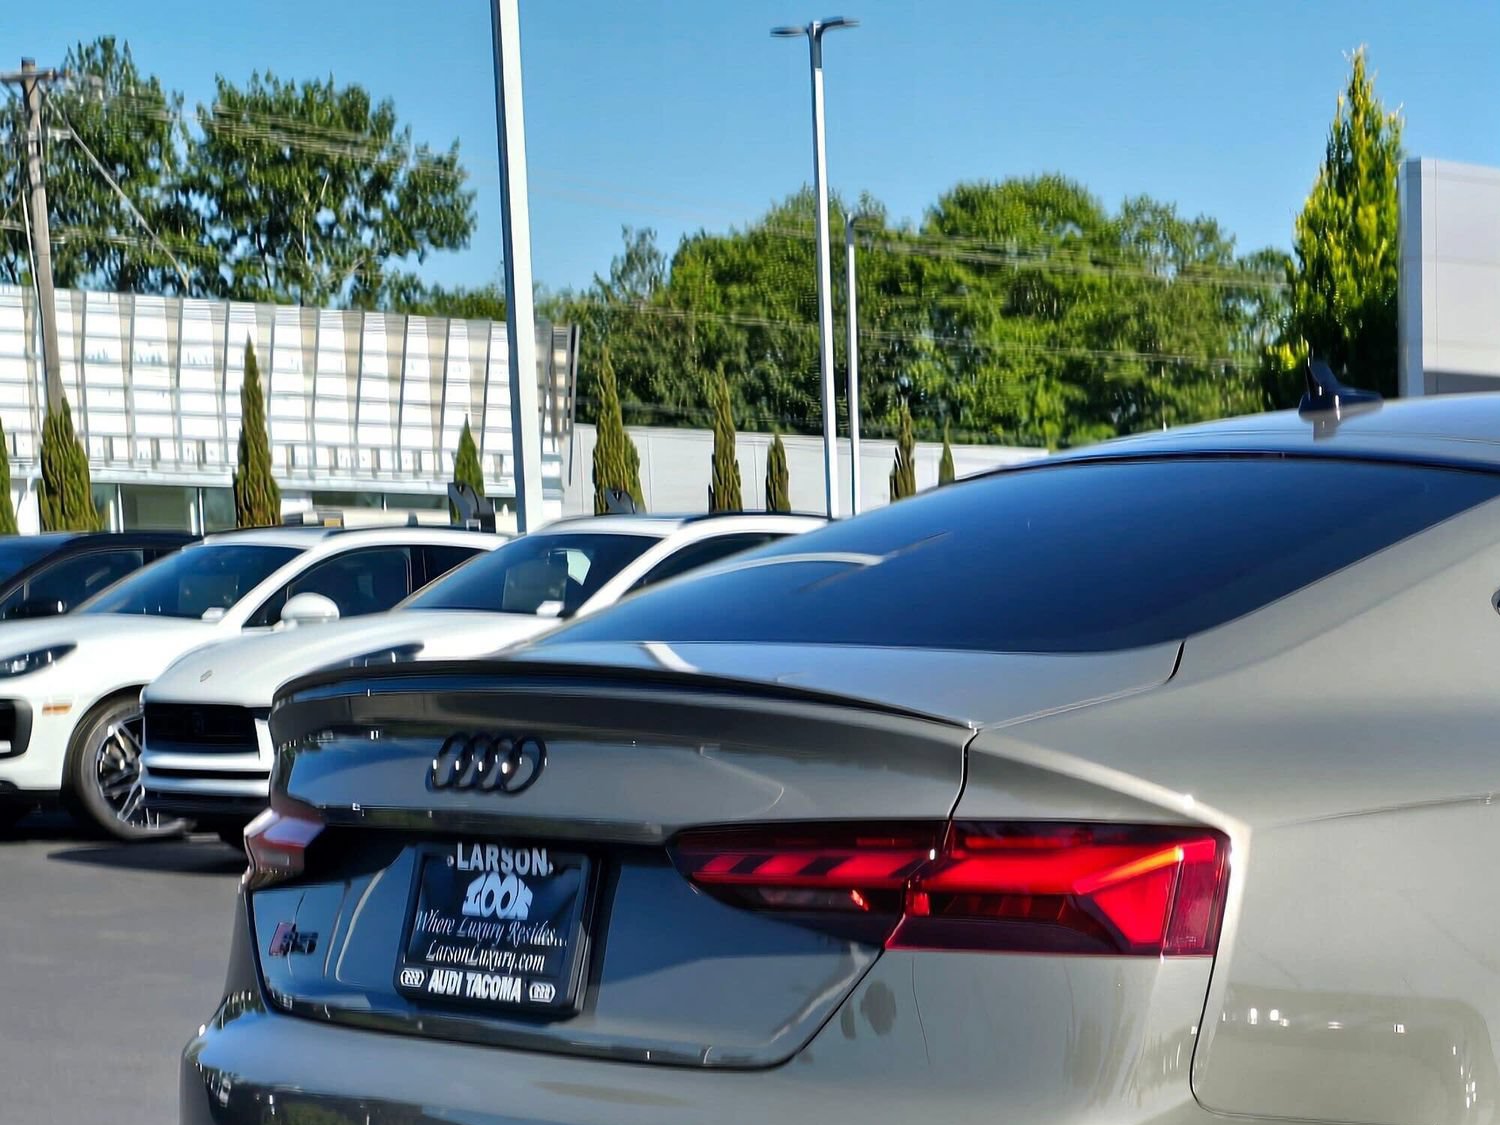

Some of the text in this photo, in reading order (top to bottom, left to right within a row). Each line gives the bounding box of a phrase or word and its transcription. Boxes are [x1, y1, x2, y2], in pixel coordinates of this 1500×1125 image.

[457, 841, 548, 876] LARSON
[416, 909, 455, 935] Where
[456, 917, 505, 945] Luxury
[425, 940, 546, 974] LarsonLuxury.com
[427, 968, 522, 1002] AUDI TACOMA
